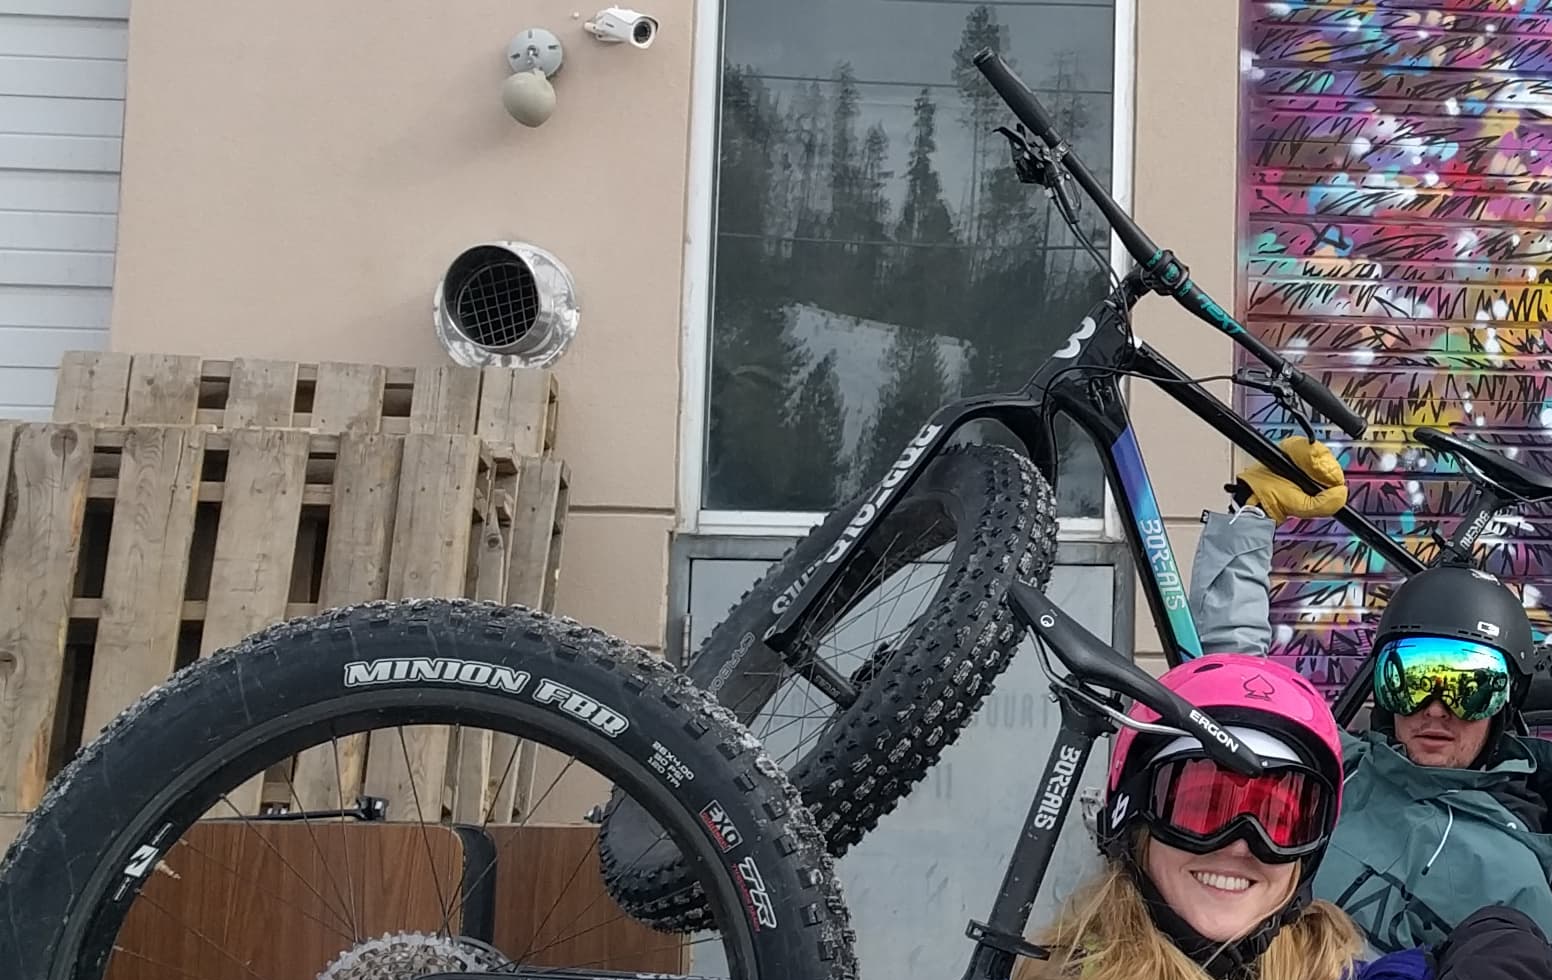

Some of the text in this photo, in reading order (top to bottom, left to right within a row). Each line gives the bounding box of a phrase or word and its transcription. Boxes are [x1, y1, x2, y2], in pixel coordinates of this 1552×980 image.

[344, 657, 630, 738] MINION FBR
[1189, 708, 1240, 754] ERGON
[707, 805, 743, 847] EXO
[738, 856, 777, 929] TR
